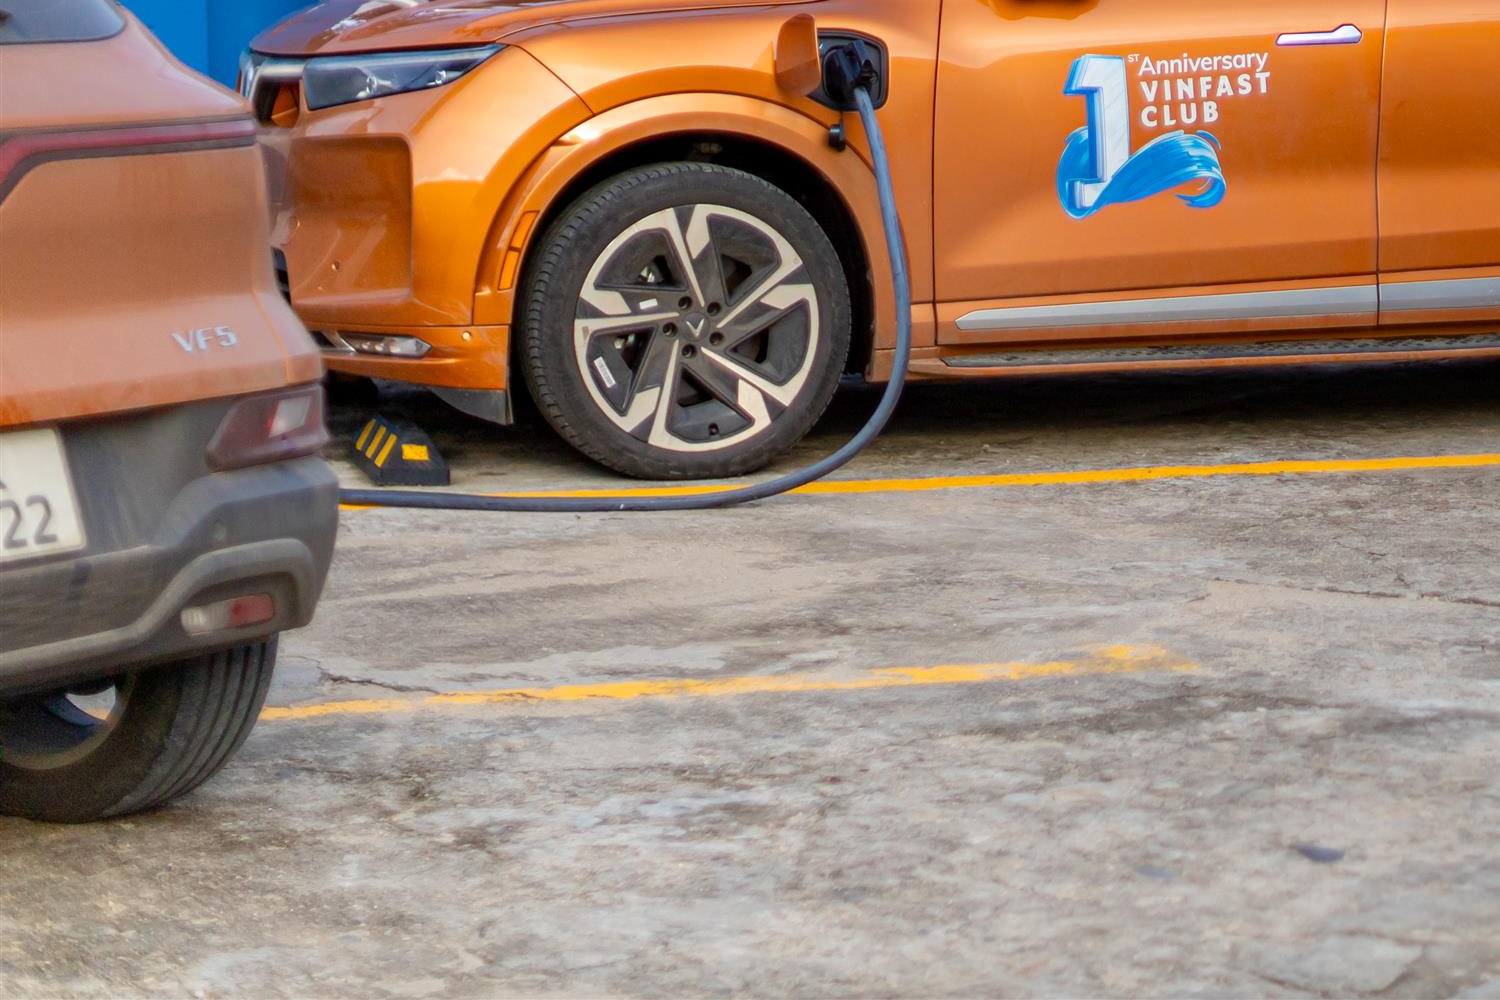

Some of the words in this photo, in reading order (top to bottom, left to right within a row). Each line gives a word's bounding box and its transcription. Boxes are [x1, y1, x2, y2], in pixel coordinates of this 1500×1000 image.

[1138, 53, 1269, 76] Anniversary
[1140, 72, 1271, 102] VINFAST
[1141, 101, 1219, 127] CLUB
[0, 495, 58, 549] 22
